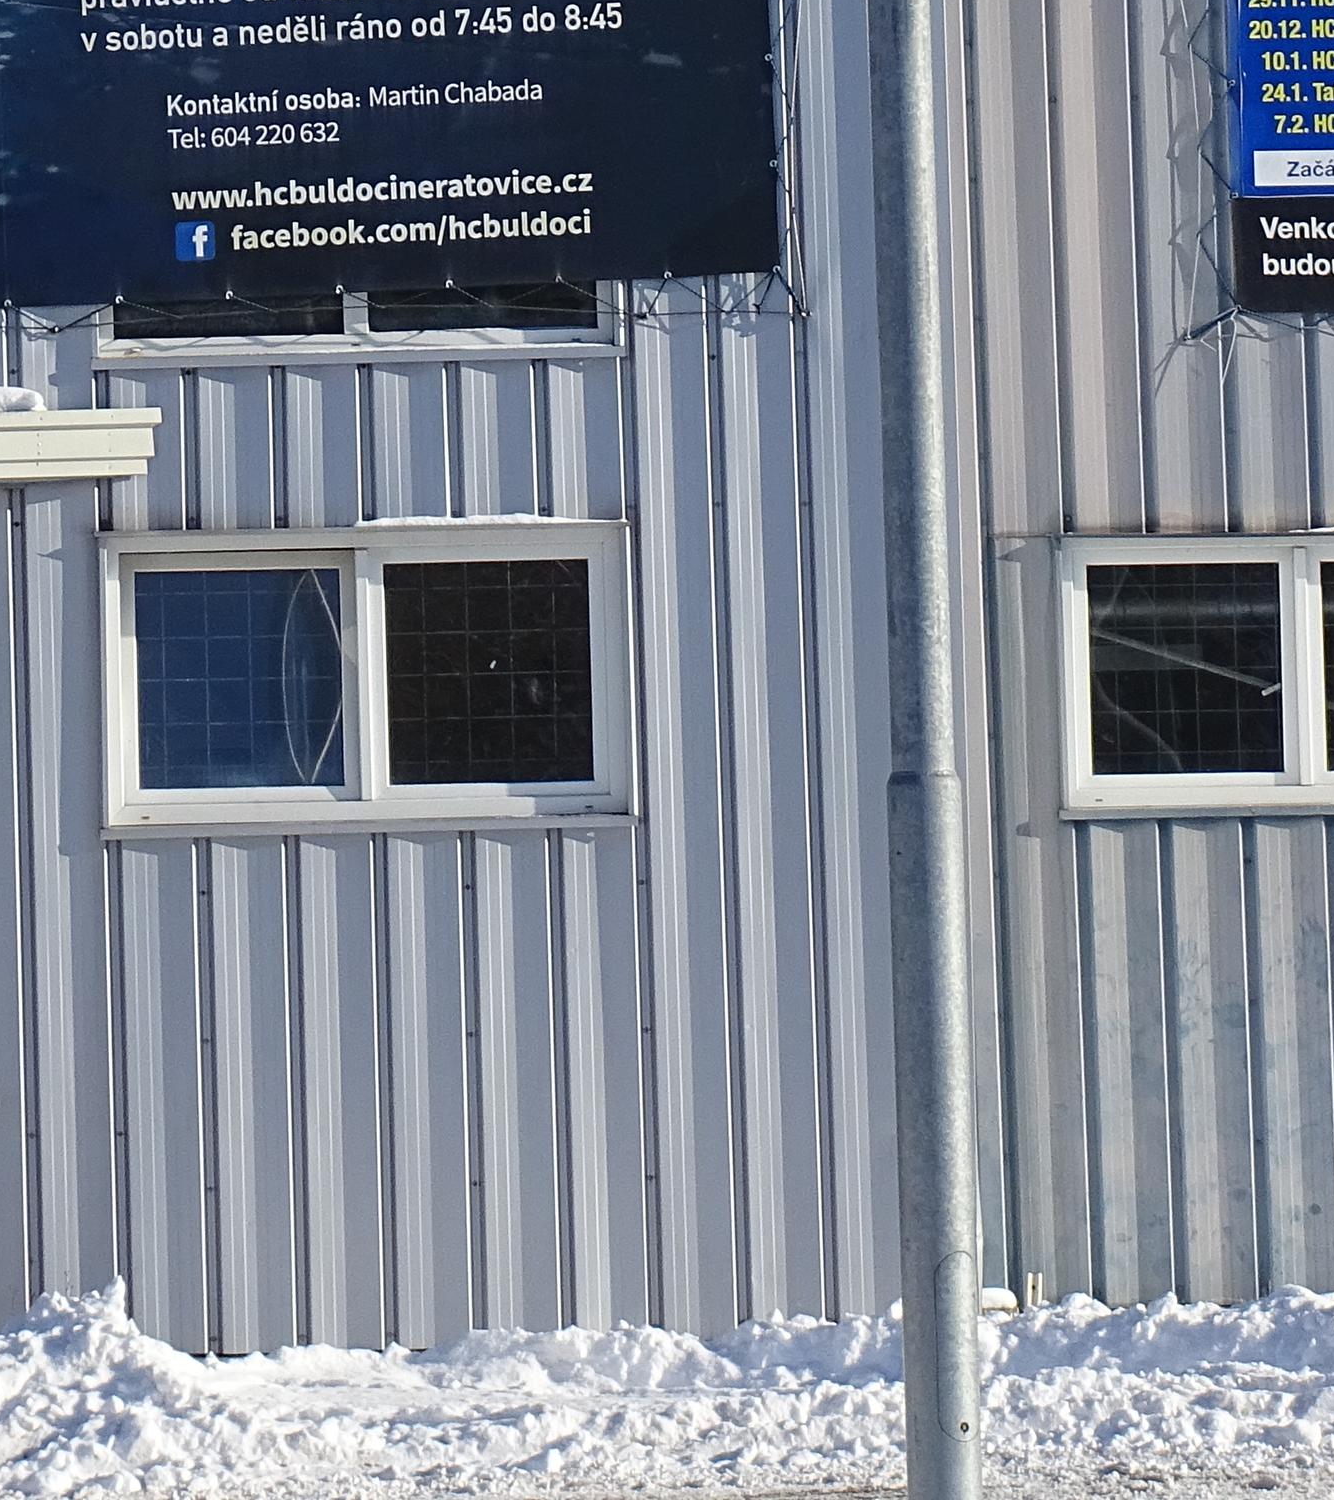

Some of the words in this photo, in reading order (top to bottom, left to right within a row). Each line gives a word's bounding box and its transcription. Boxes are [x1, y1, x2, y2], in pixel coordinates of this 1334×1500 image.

[80, 32, 97, 52] v
[105, 23, 203, 52] sobotu
[212, 26, 228, 47] a
[239, 14, 326, 46] neděli
[336, 12, 402, 41] ráno
[411, 9, 446, 37] od
[454, 6, 512, 36] 7:45
[522, 5, 556, 33] do
[564, 2, 622, 31] 8:45
[1248, 19, 1307, 39] 20.12.
[1261, 51, 1308, 71] 10.1.
[167, 89, 279, 117] Kontaktní
[285, 87, 361, 111] osoba:
[369, 83, 439, 107] Martin
[444, 78, 543, 104] Chabada
[1261, 82, 1308, 103] 24.1.
[167, 126, 206, 149] Tel:
[211, 126, 252, 148] 604
[255, 123, 295, 145] 220
[300, 121, 340, 143] 632
[1274, 114, 1309, 134] 7.2.
[171, 168, 593, 210] www.hcbuldocineratovice.cz
[230, 208, 591, 250] facebook.com/hcbuldoci
